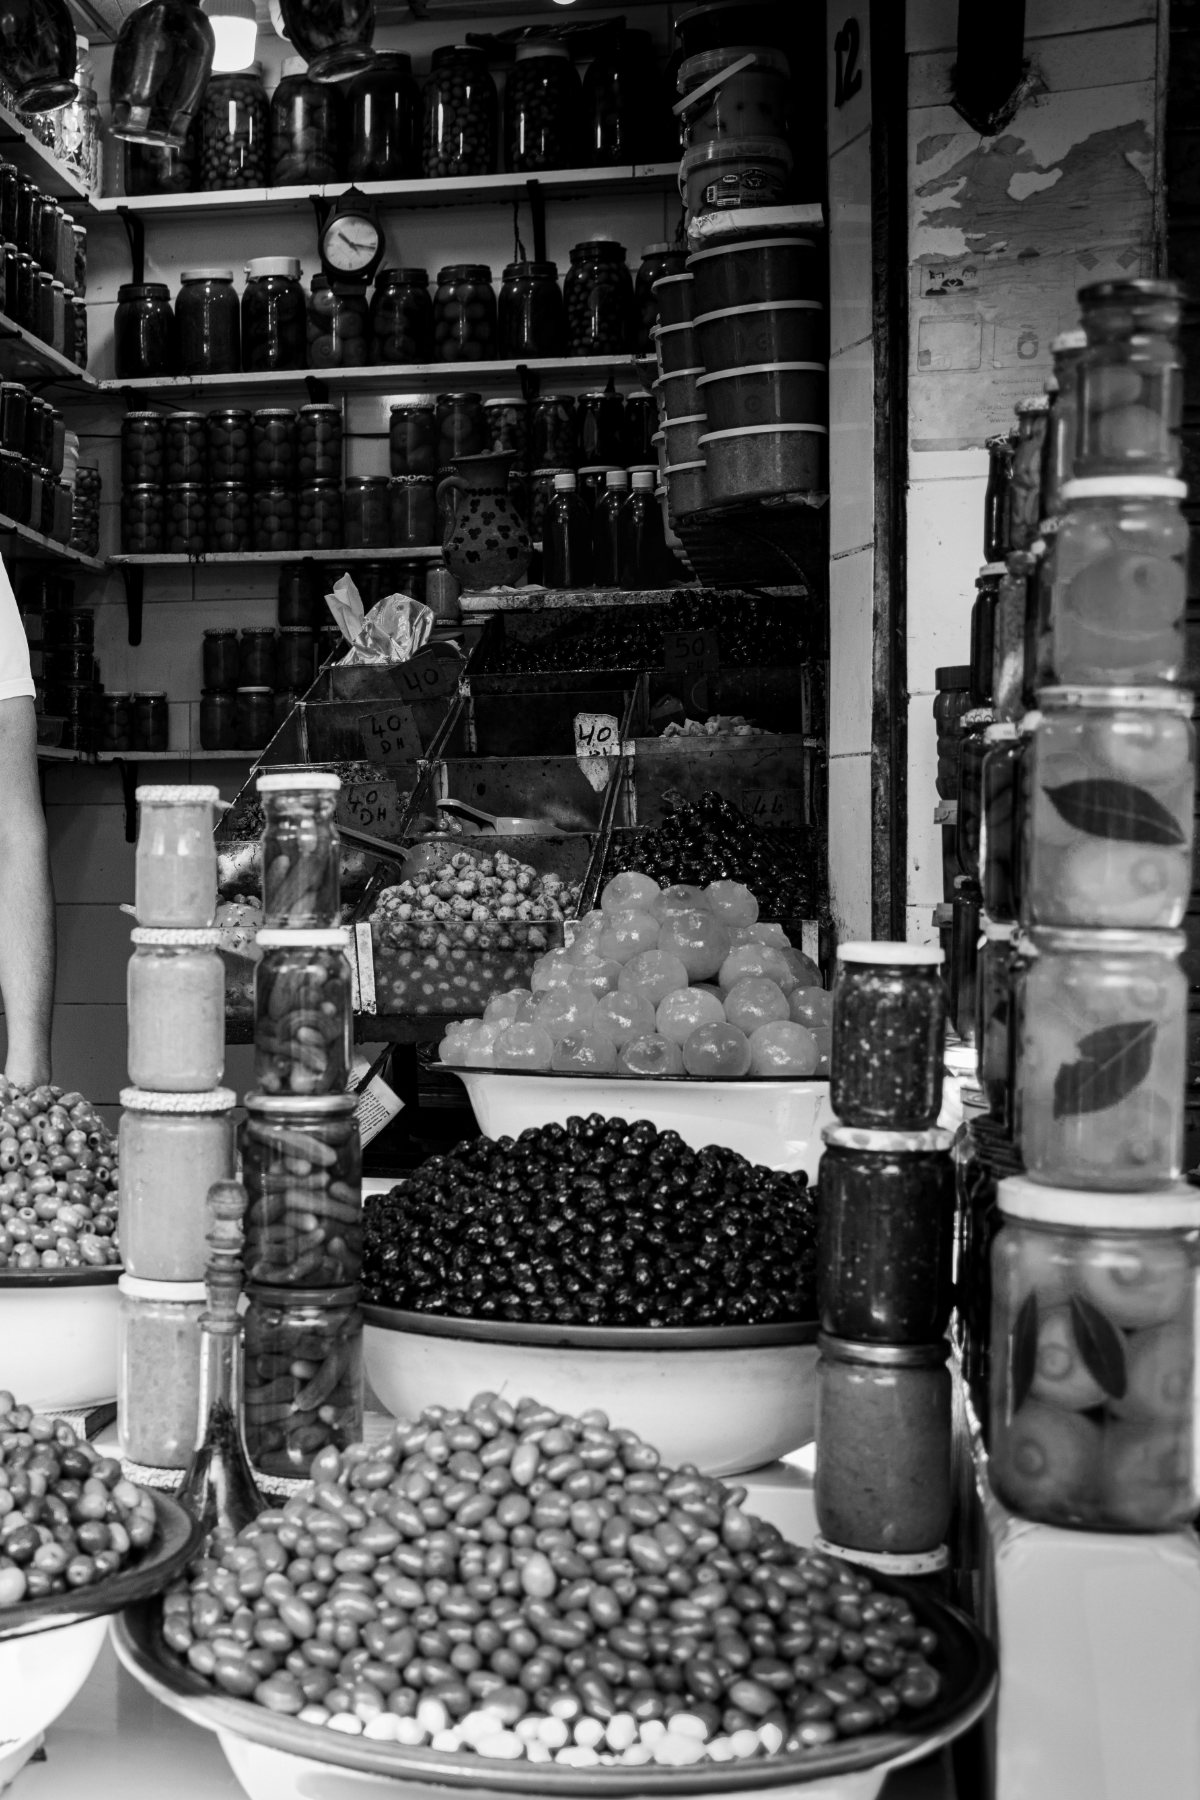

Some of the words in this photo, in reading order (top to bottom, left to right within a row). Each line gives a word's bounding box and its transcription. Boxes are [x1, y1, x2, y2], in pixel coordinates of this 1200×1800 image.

[834, 18, 862, 110] 12
[675, 637, 704, 658] 50
[402, 668, 439, 692] 40
[371, 715, 401, 738] 40
[579, 724, 611, 745] 40
[380, 737, 404, 754] DH
[348, 787, 378, 813] 40
[360, 807, 386, 826] DH
